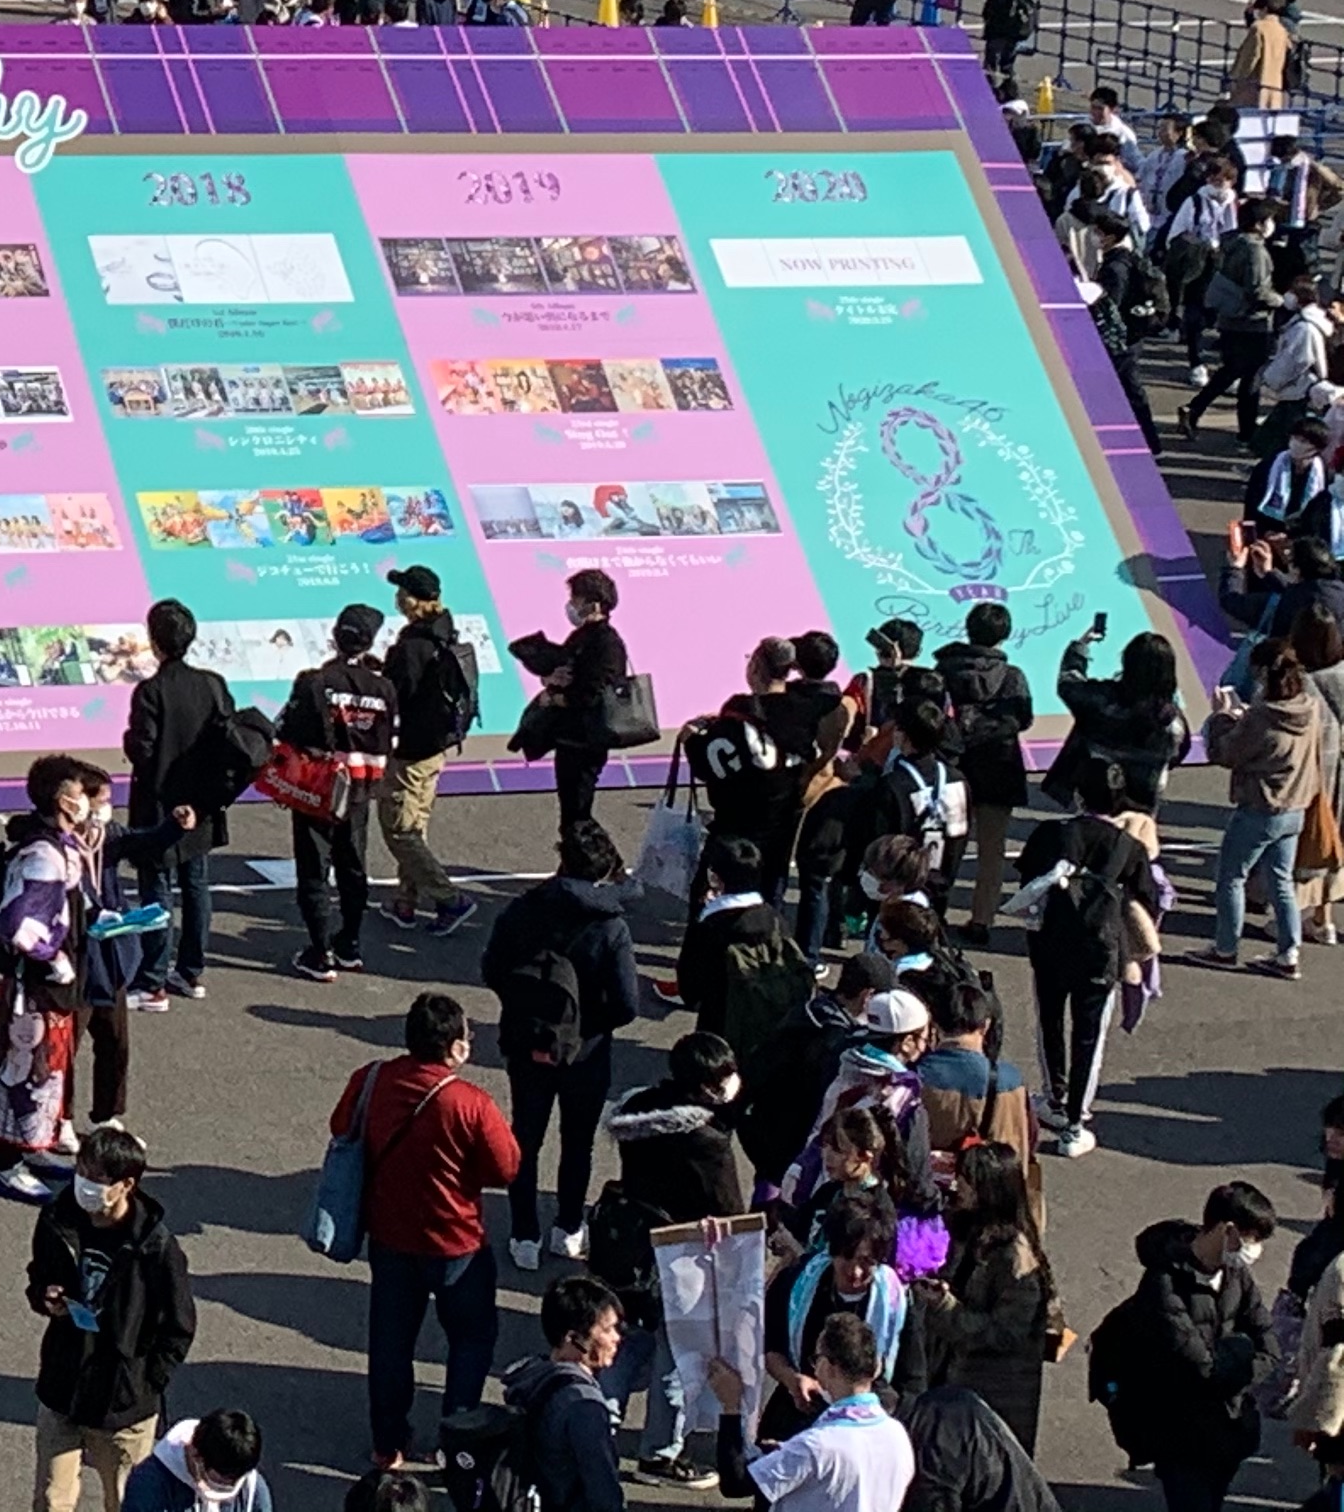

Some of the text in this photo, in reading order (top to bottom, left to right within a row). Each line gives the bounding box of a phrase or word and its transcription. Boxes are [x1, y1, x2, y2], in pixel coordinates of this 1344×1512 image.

[143, 172, 252, 207] 2018
[457, 171, 561, 205] 2019
[765, 169, 868, 203] 2020
[779, 256, 915, 271] NOW PRINTING
[816, 381, 1011, 435] Nogizaka46
[955, 585, 1004, 600] YEAR
